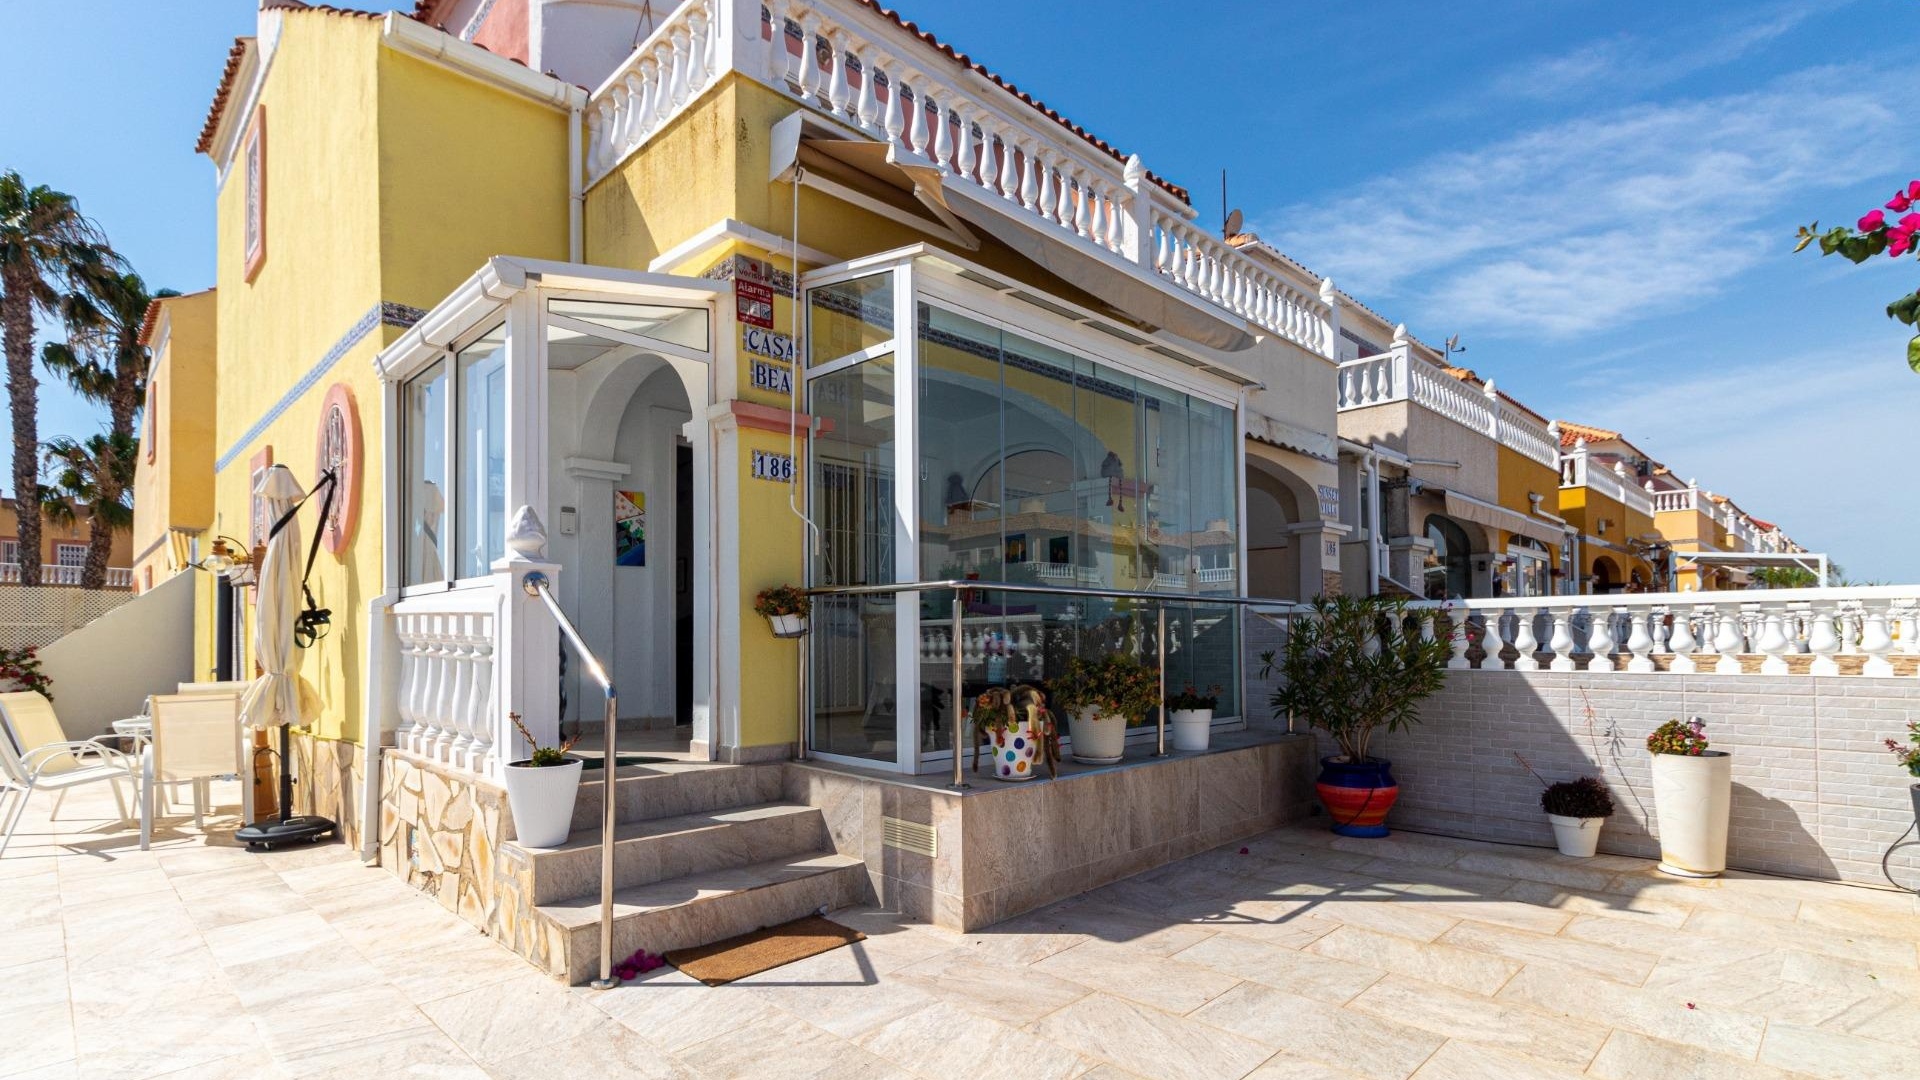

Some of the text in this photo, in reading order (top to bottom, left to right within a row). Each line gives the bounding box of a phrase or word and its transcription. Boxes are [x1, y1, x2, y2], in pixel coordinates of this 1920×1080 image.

[738, 282, 771, 298] Alarma
[748, 330, 794, 359] CASA
[756, 364, 791, 393] BEA
[757, 455, 791, 478] 186
